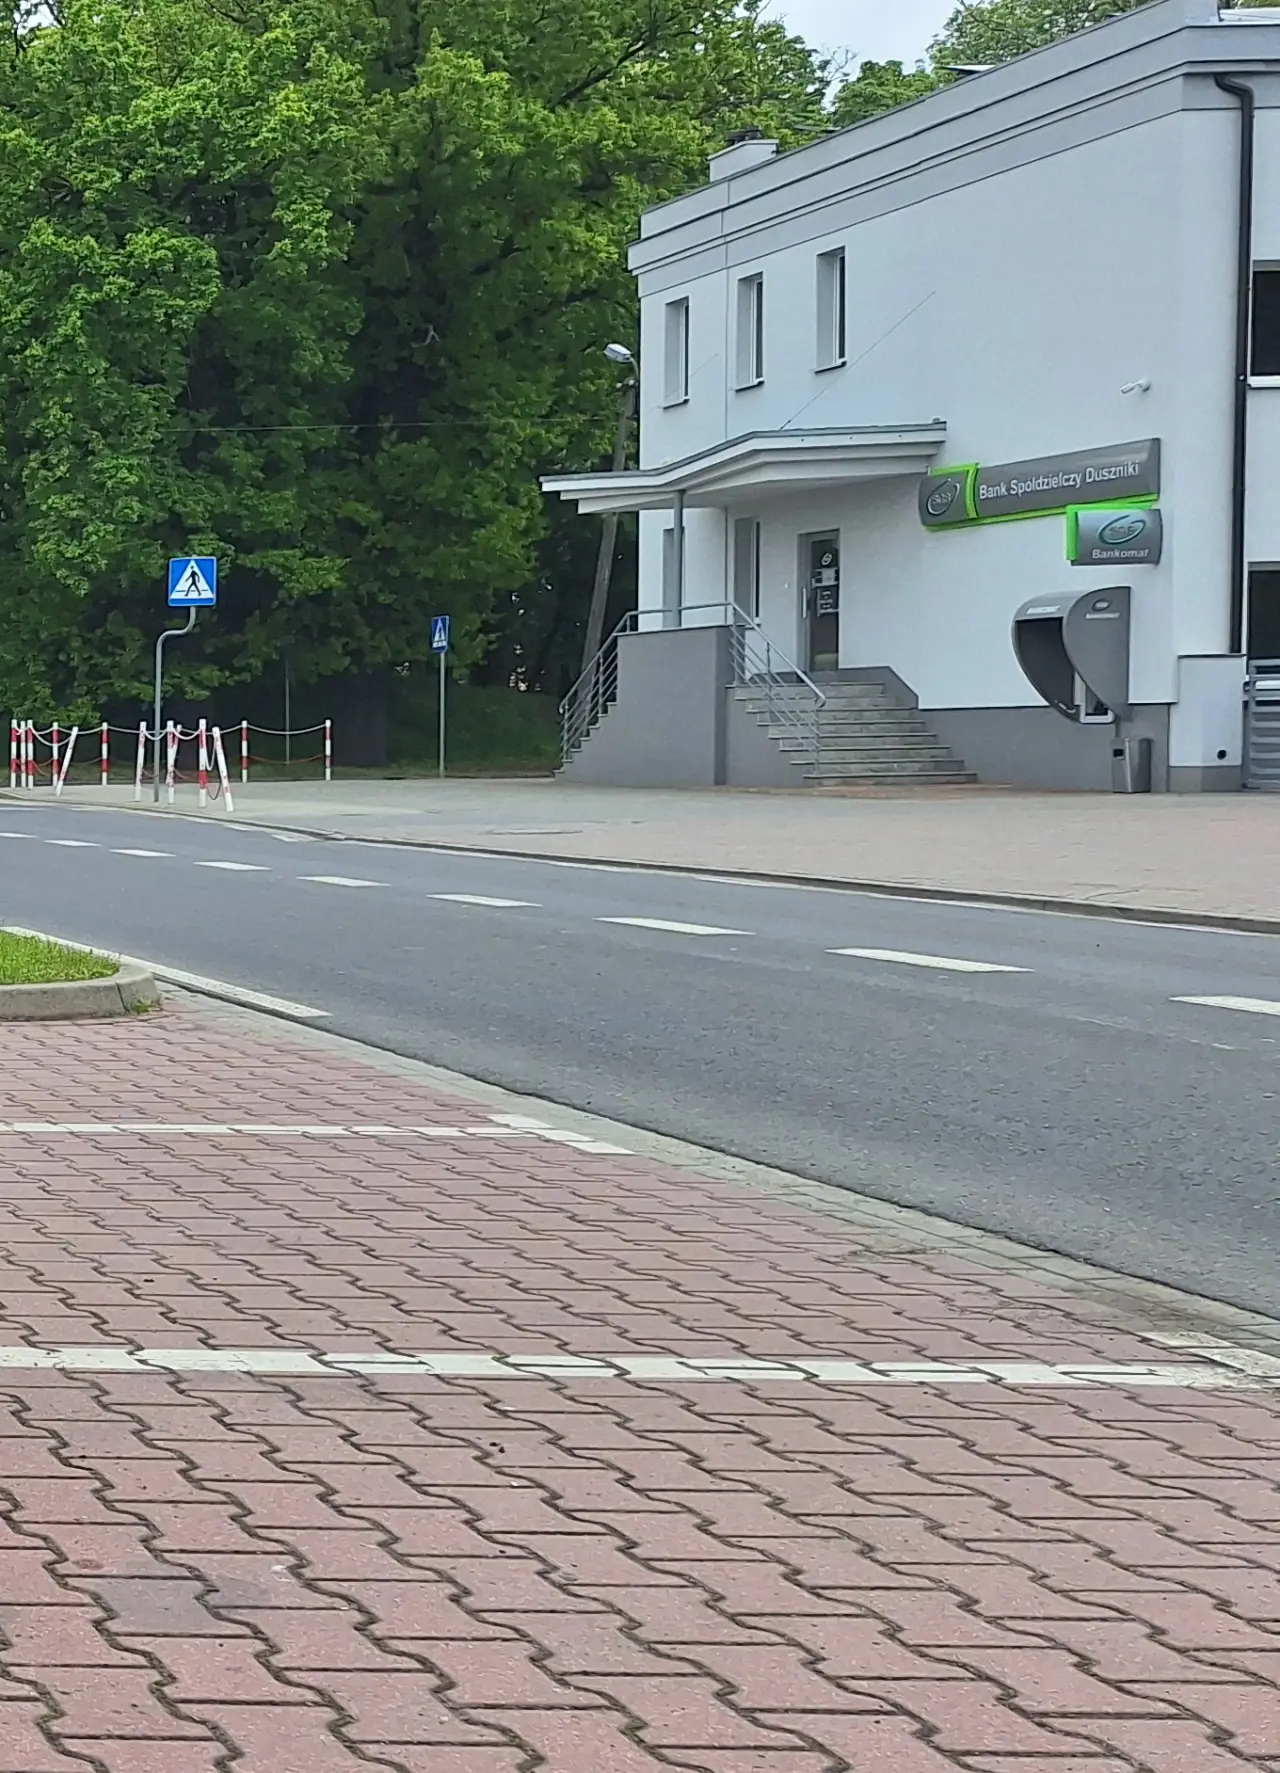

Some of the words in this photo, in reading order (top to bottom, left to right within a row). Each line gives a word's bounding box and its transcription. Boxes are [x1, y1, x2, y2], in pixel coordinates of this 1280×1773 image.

[980, 482, 1008, 500] Bank
[1085, 460, 1139, 483] Duszniki
[1092, 549, 1149, 559] Bankomat
